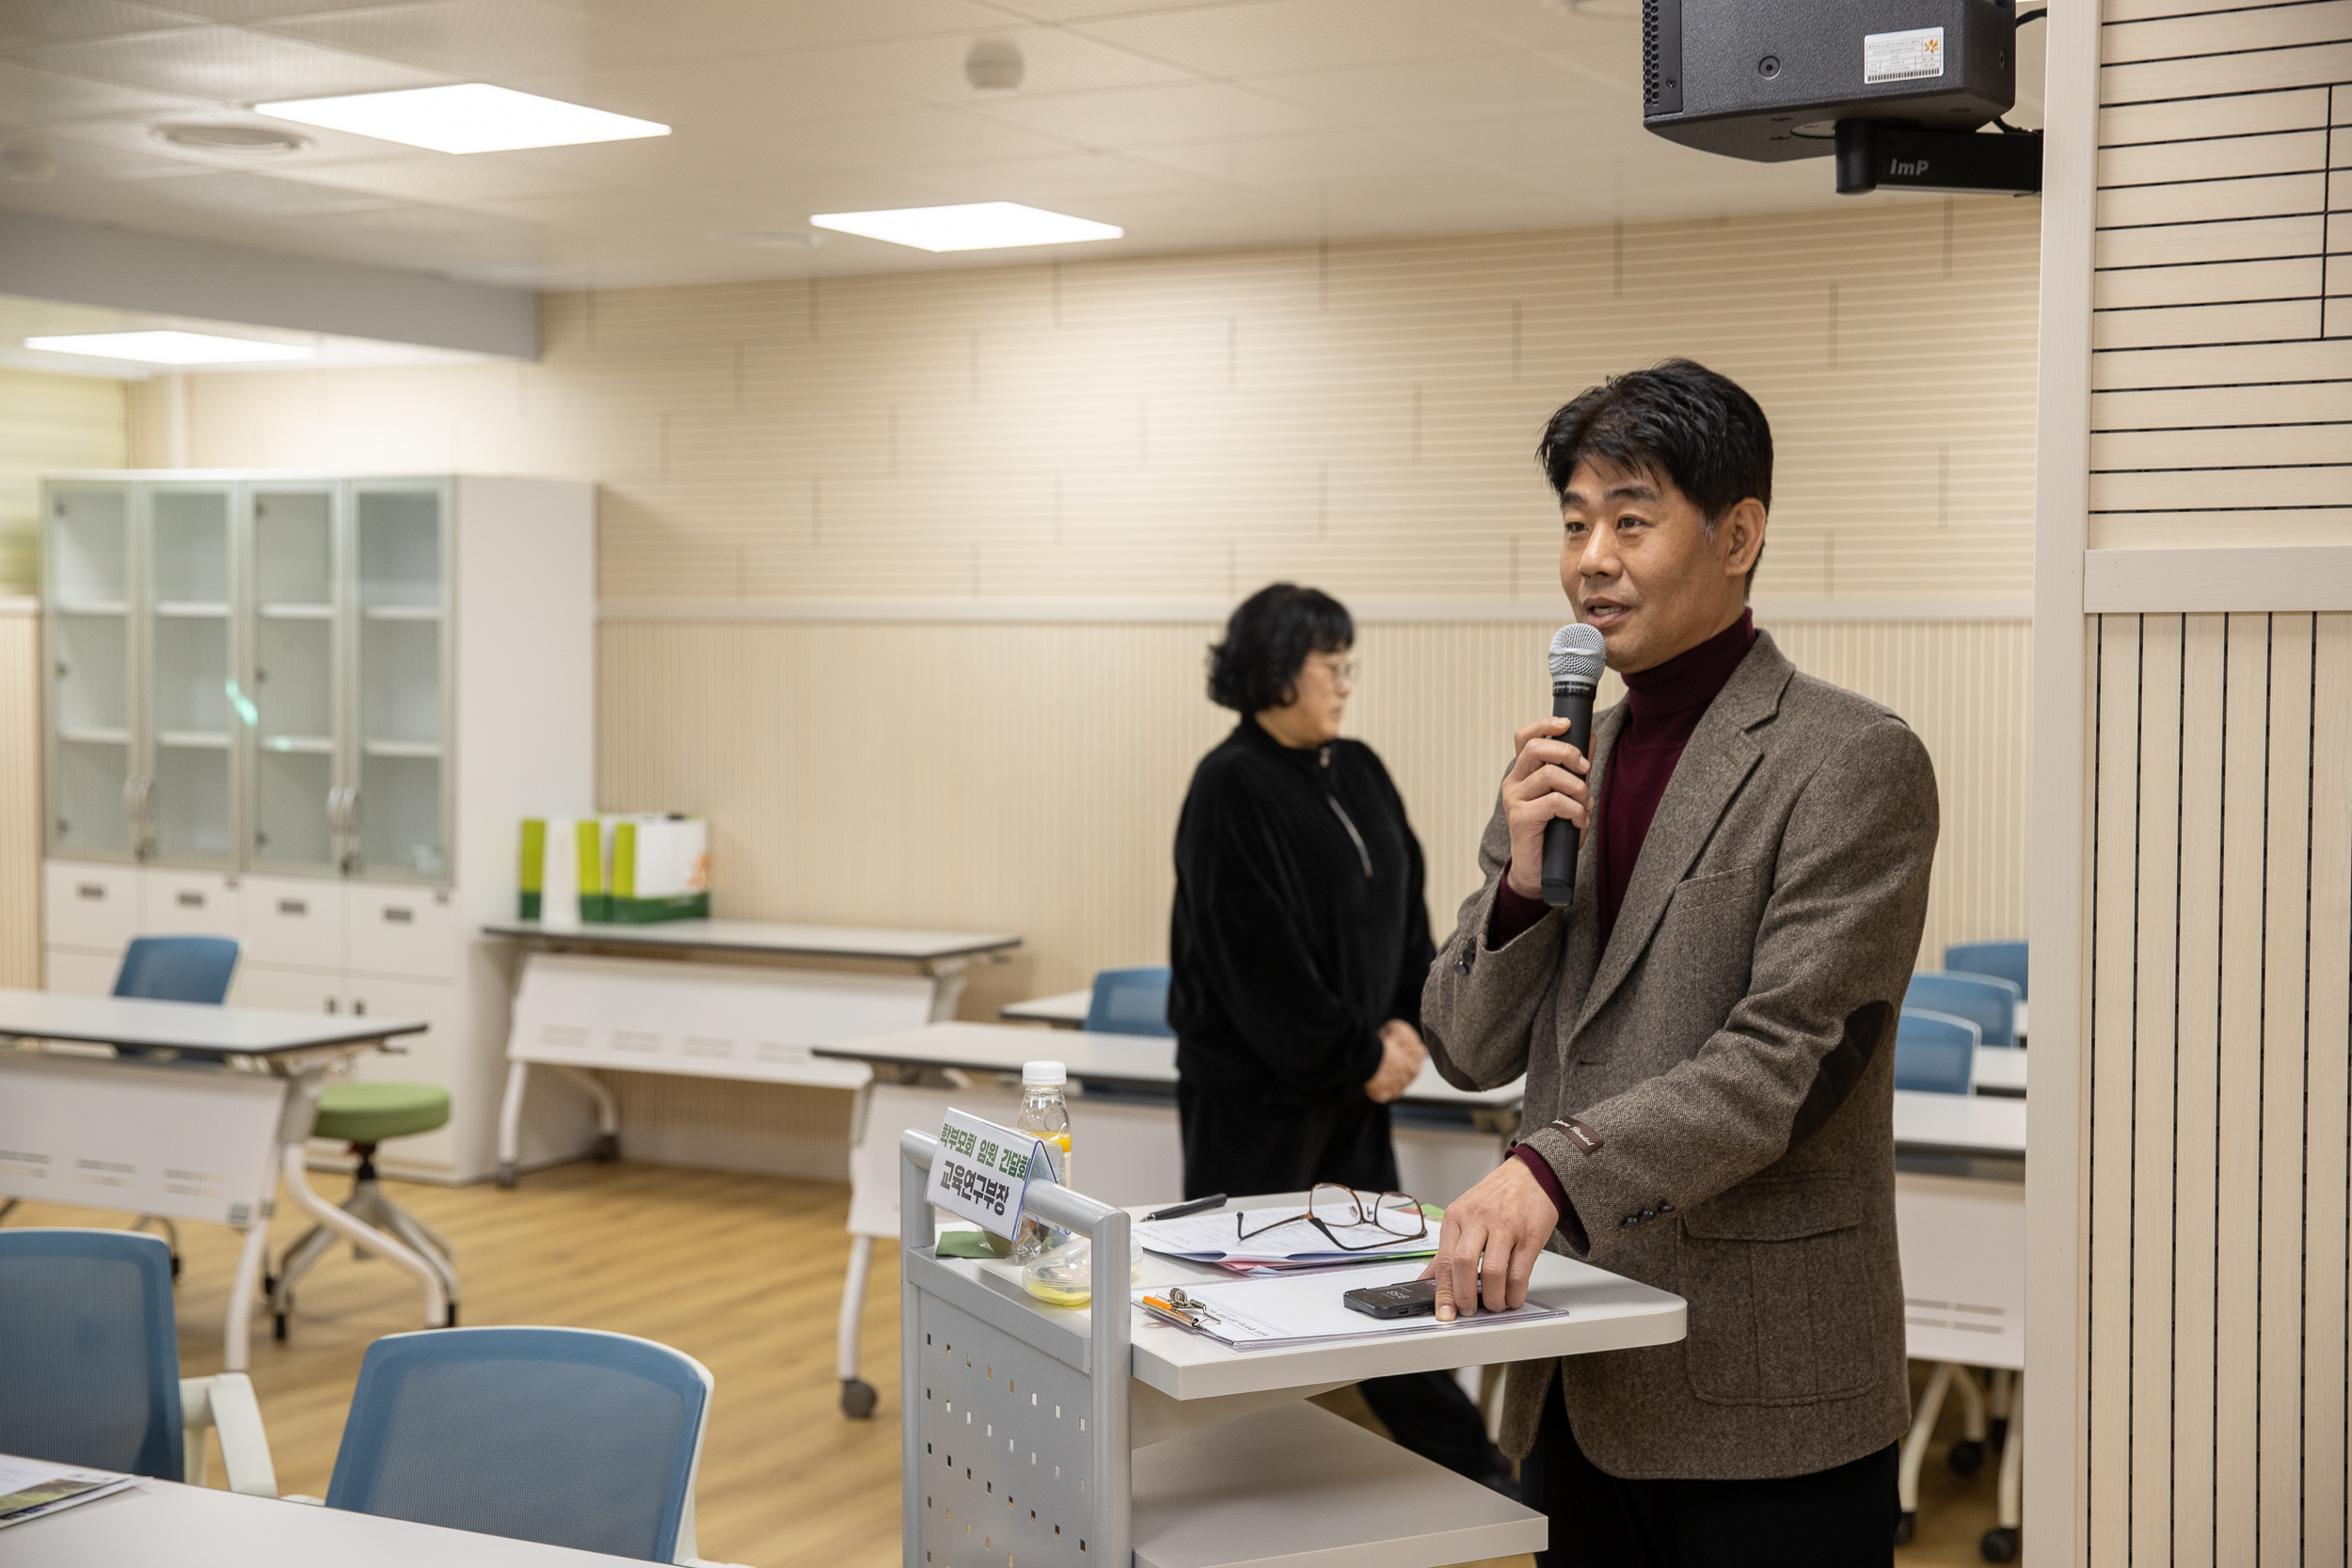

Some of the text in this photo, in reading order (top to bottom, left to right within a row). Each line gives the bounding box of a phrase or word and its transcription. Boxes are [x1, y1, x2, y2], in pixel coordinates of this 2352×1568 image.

[1889, 158, 1930, 176] ImP
[940, 1123, 1031, 1181] 학부모회 임원 간담회
[940, 1160, 1010, 1216] 교육연구부장
